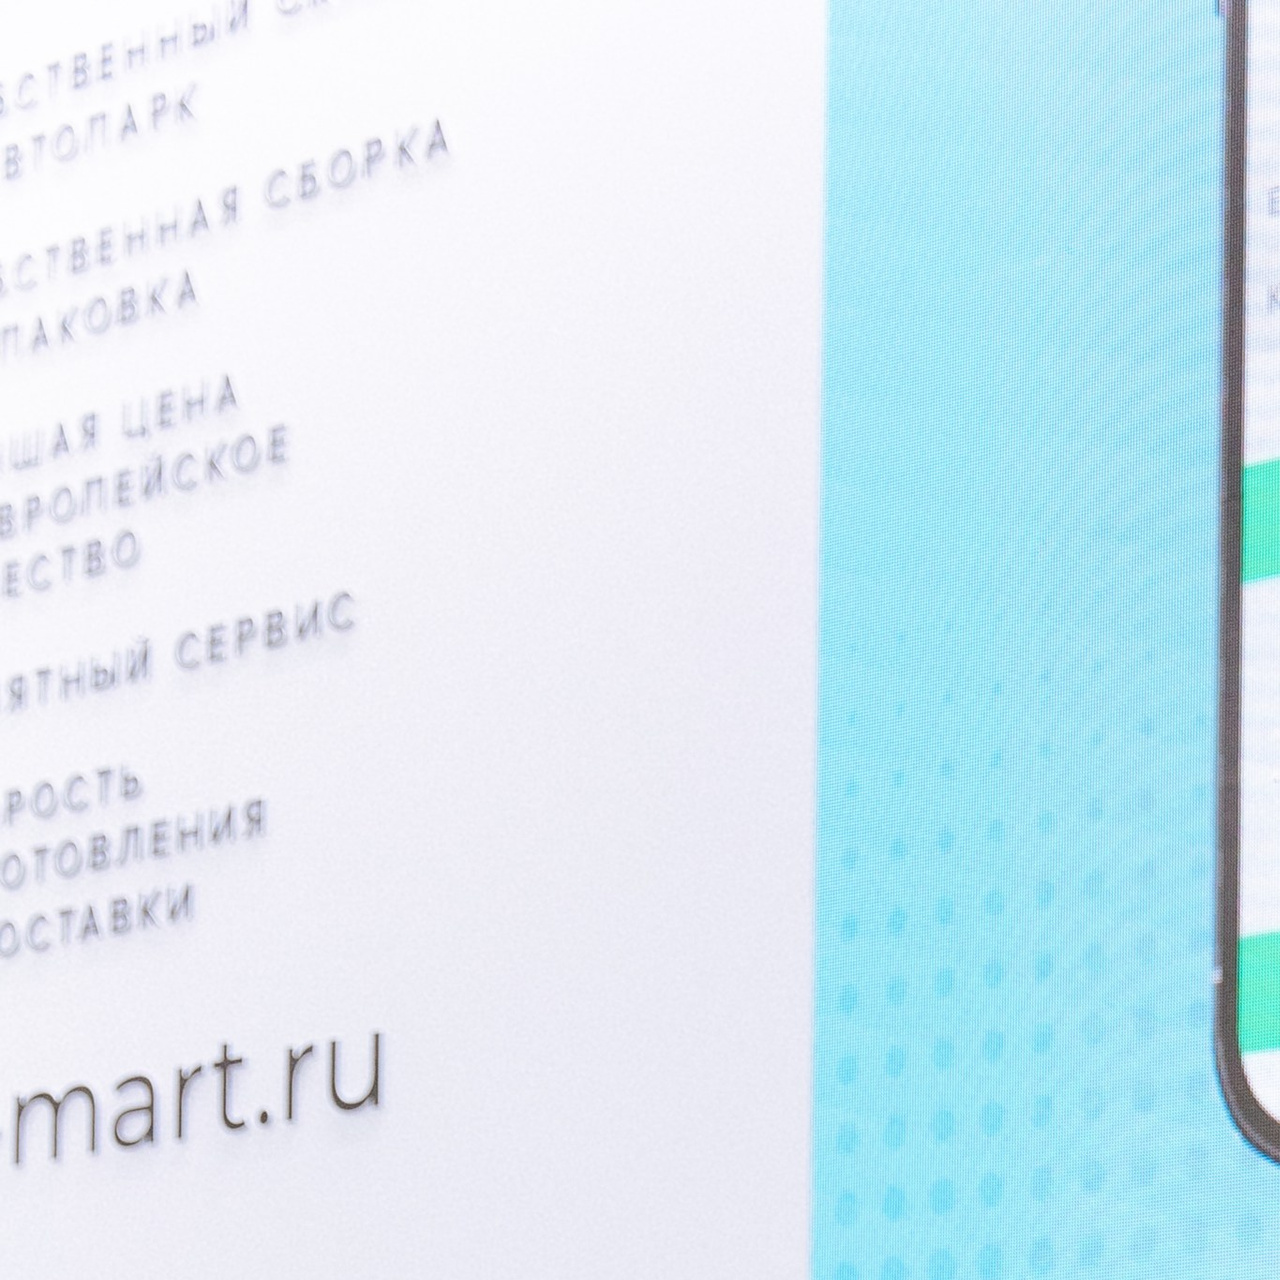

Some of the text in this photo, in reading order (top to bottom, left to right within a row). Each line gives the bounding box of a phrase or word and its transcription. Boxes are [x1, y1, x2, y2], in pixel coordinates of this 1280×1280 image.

[4, 82, 197, 181] ВТОПАРК
[0, 118, 450, 297] СТВЕННАЯ СБОРКА
[0, 268, 198, 360] ПАКОВКА
[120, 373, 240, 440] ЦЕНА
[0, 421, 290, 540] ВРОПЕЙСКОЕ
[2, 528, 142, 598] ЕСТВО
[6, 590, 355, 713] ЯТНЫЙ СЕРВИС
[3, 764, 144, 826] РОСТЬ
[0, 797, 268, 890] ОТОВЛЕНИЯ
[0, 882, 195, 958] ОСТАВКИ
